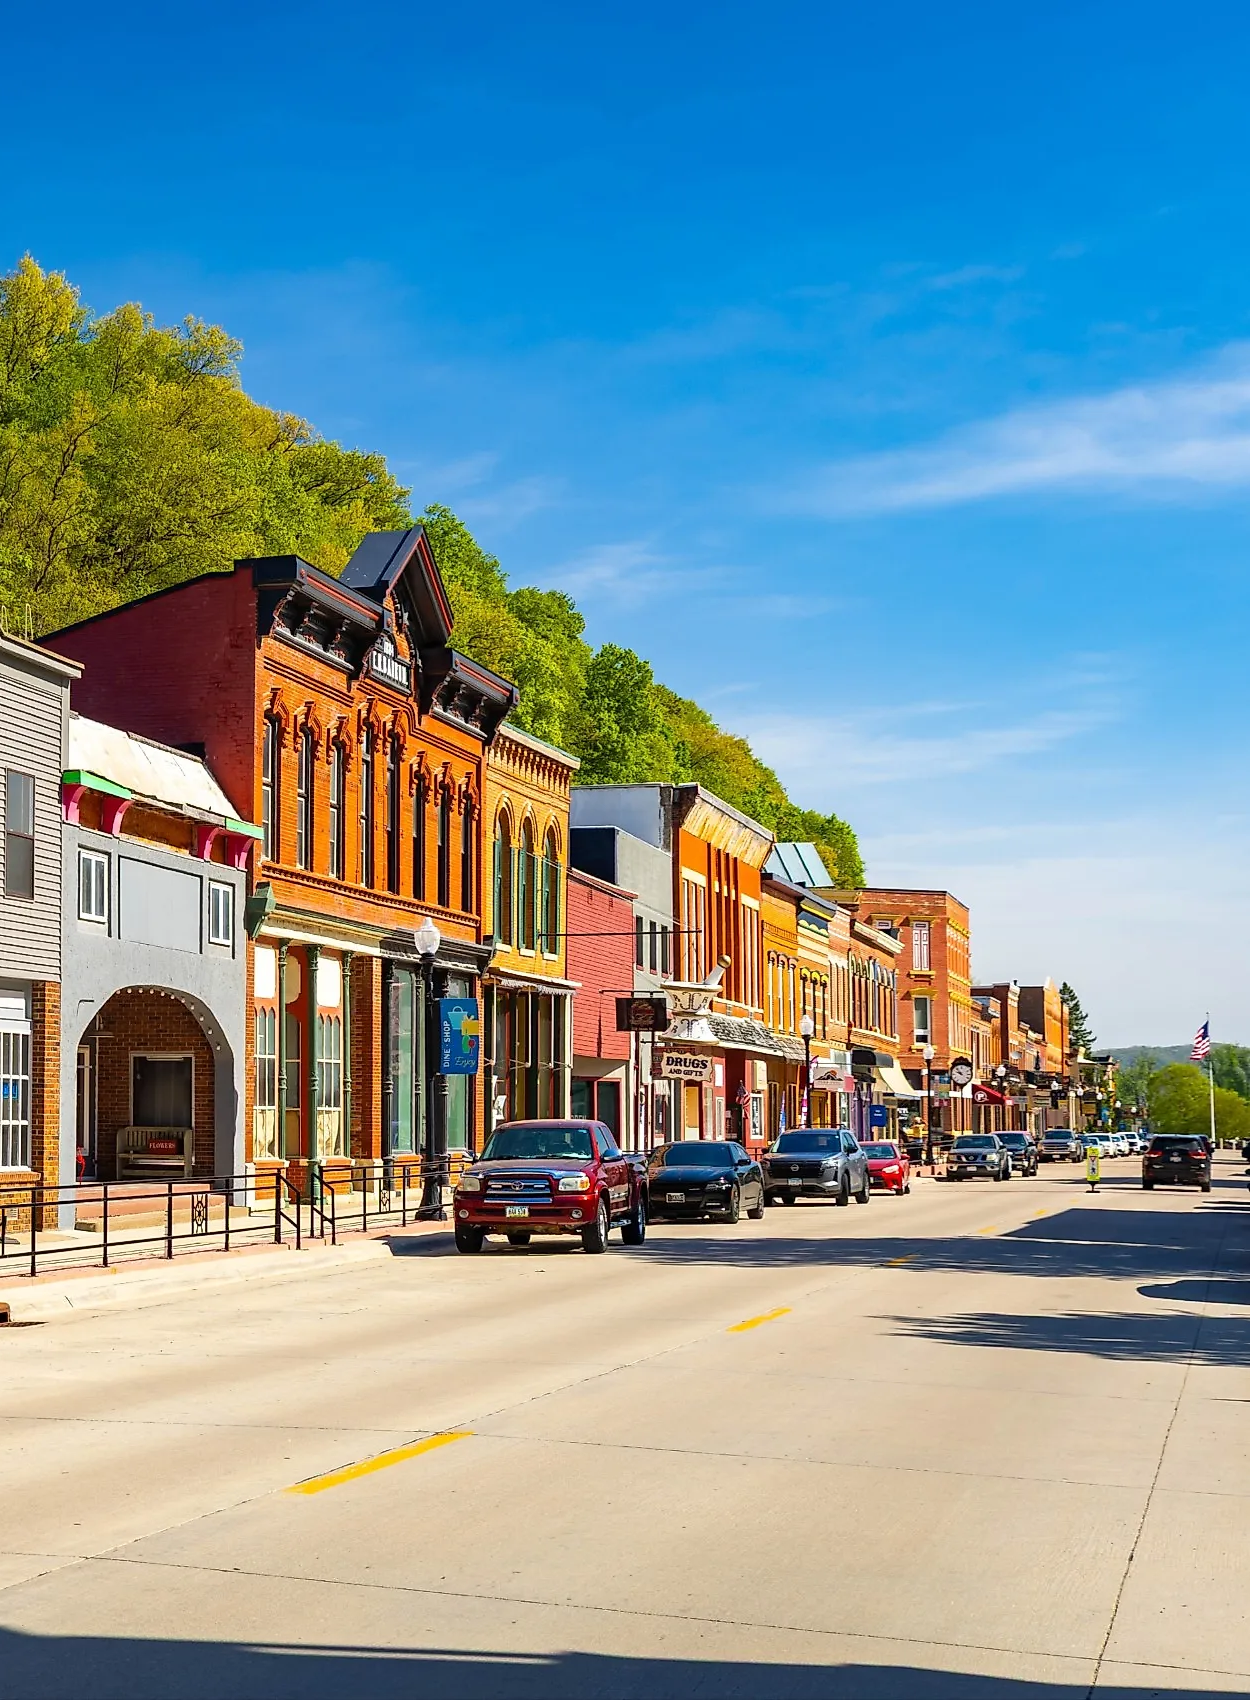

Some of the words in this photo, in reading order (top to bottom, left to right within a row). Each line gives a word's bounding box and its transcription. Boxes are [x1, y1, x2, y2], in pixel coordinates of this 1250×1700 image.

[443, 1020, 451, 1044] SHOP
[443, 1048, 451, 1068] DINE
[454, 1056, 476, 1068] Enjoy
[665, 1056, 709, 1070] DRUGS
[682, 1069, 704, 1077] GIFTS
